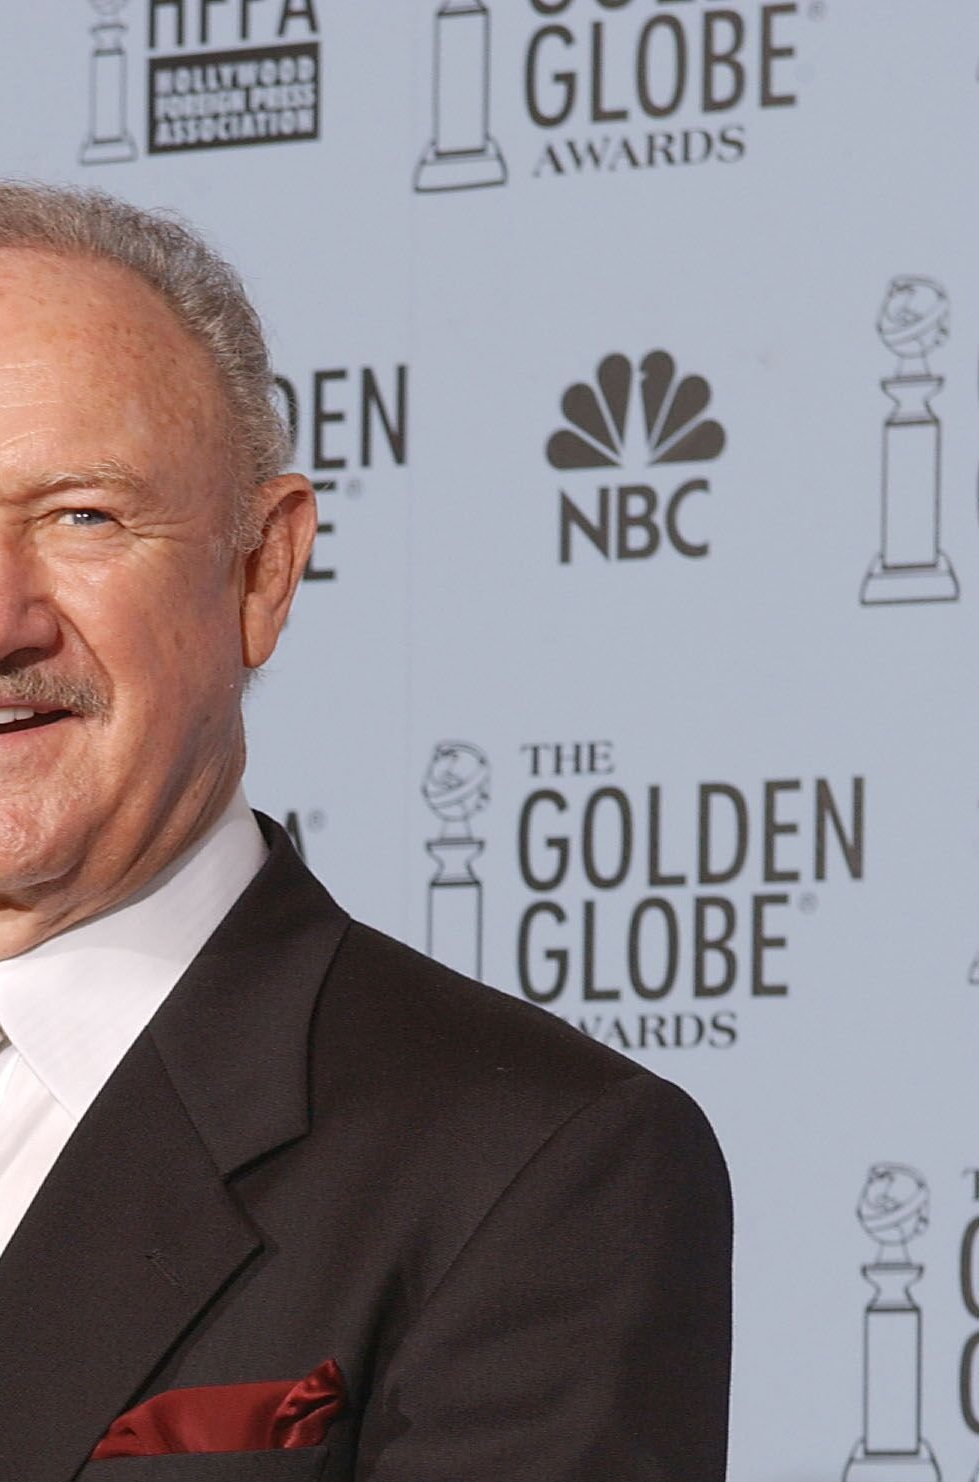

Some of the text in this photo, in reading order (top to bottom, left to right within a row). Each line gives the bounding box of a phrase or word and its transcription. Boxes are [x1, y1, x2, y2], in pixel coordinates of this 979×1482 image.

[525, 2, 797, 129] GLOBE
[532, 124, 746, 178] AWARDS
[558, 478, 711, 564] NBC
[521, 741, 615, 777] THE
[518, 776, 864, 892] GOLDEN
[517, 893, 789, 1003] GLOBE
